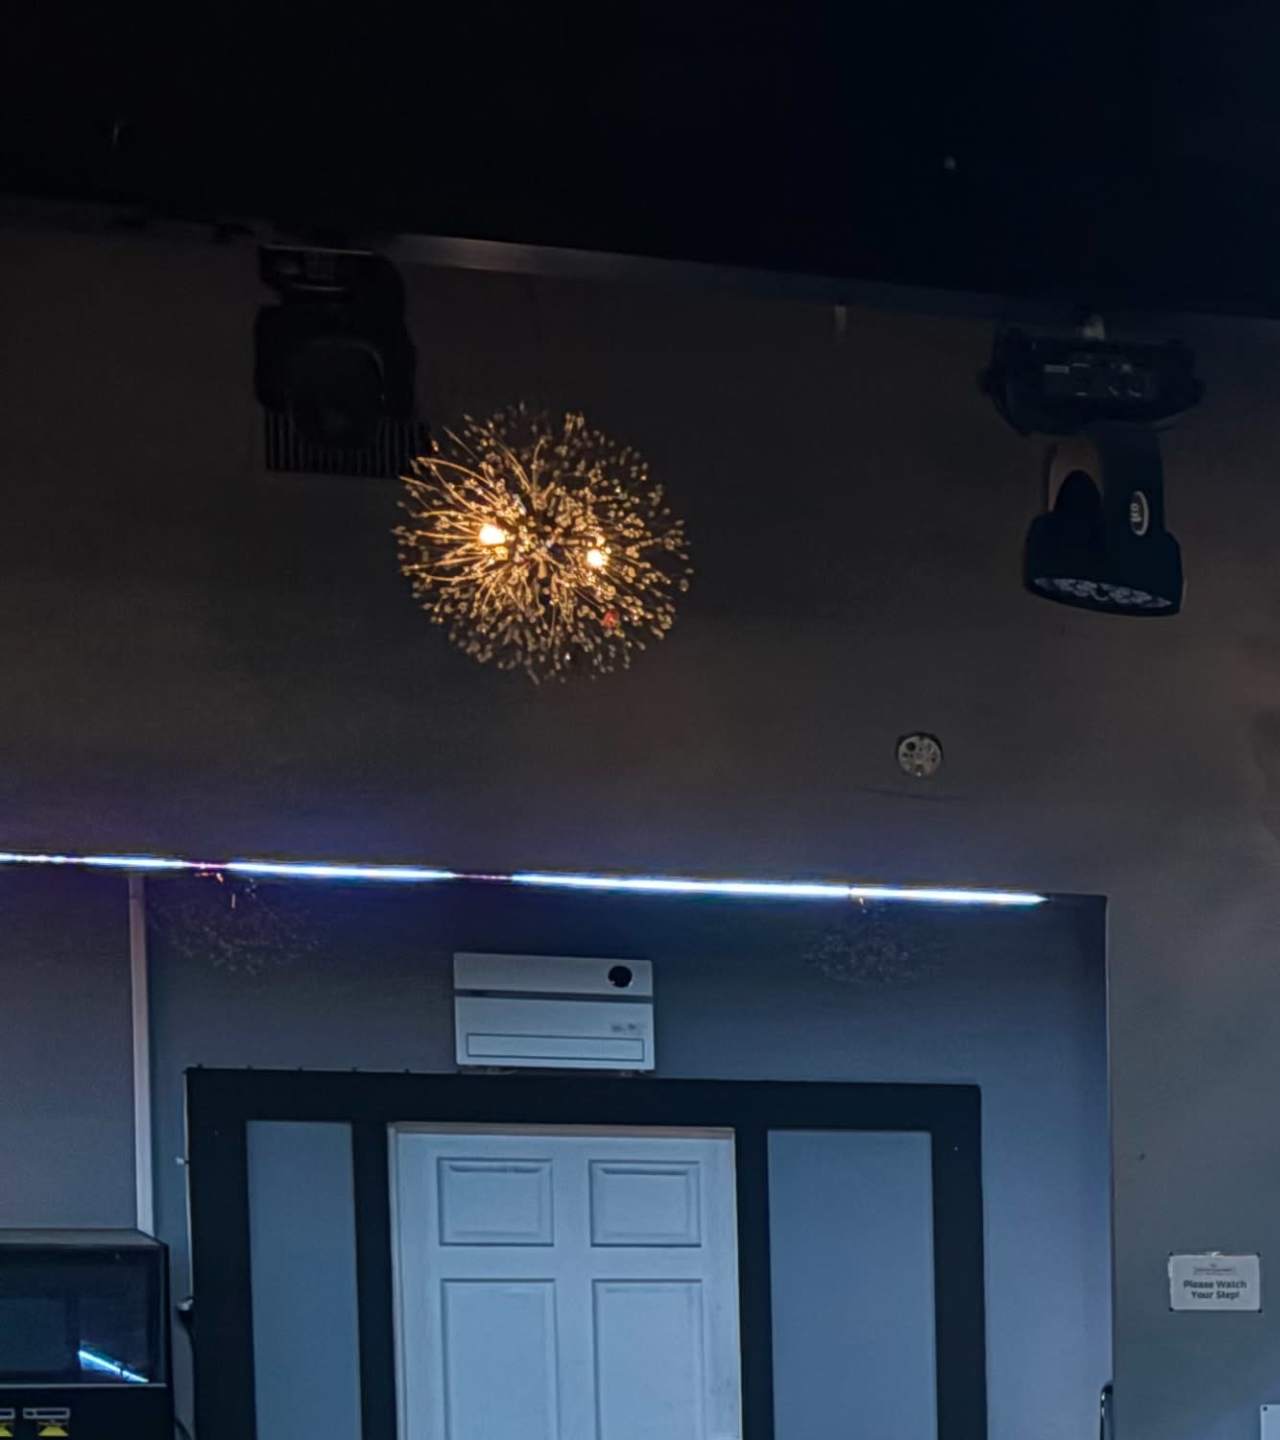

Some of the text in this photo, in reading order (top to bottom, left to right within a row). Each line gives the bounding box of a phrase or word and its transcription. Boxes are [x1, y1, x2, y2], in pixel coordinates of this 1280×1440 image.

[1183, 1279, 1247, 1289] Please Watch
[1191, 1290, 1213, 1299] Your
